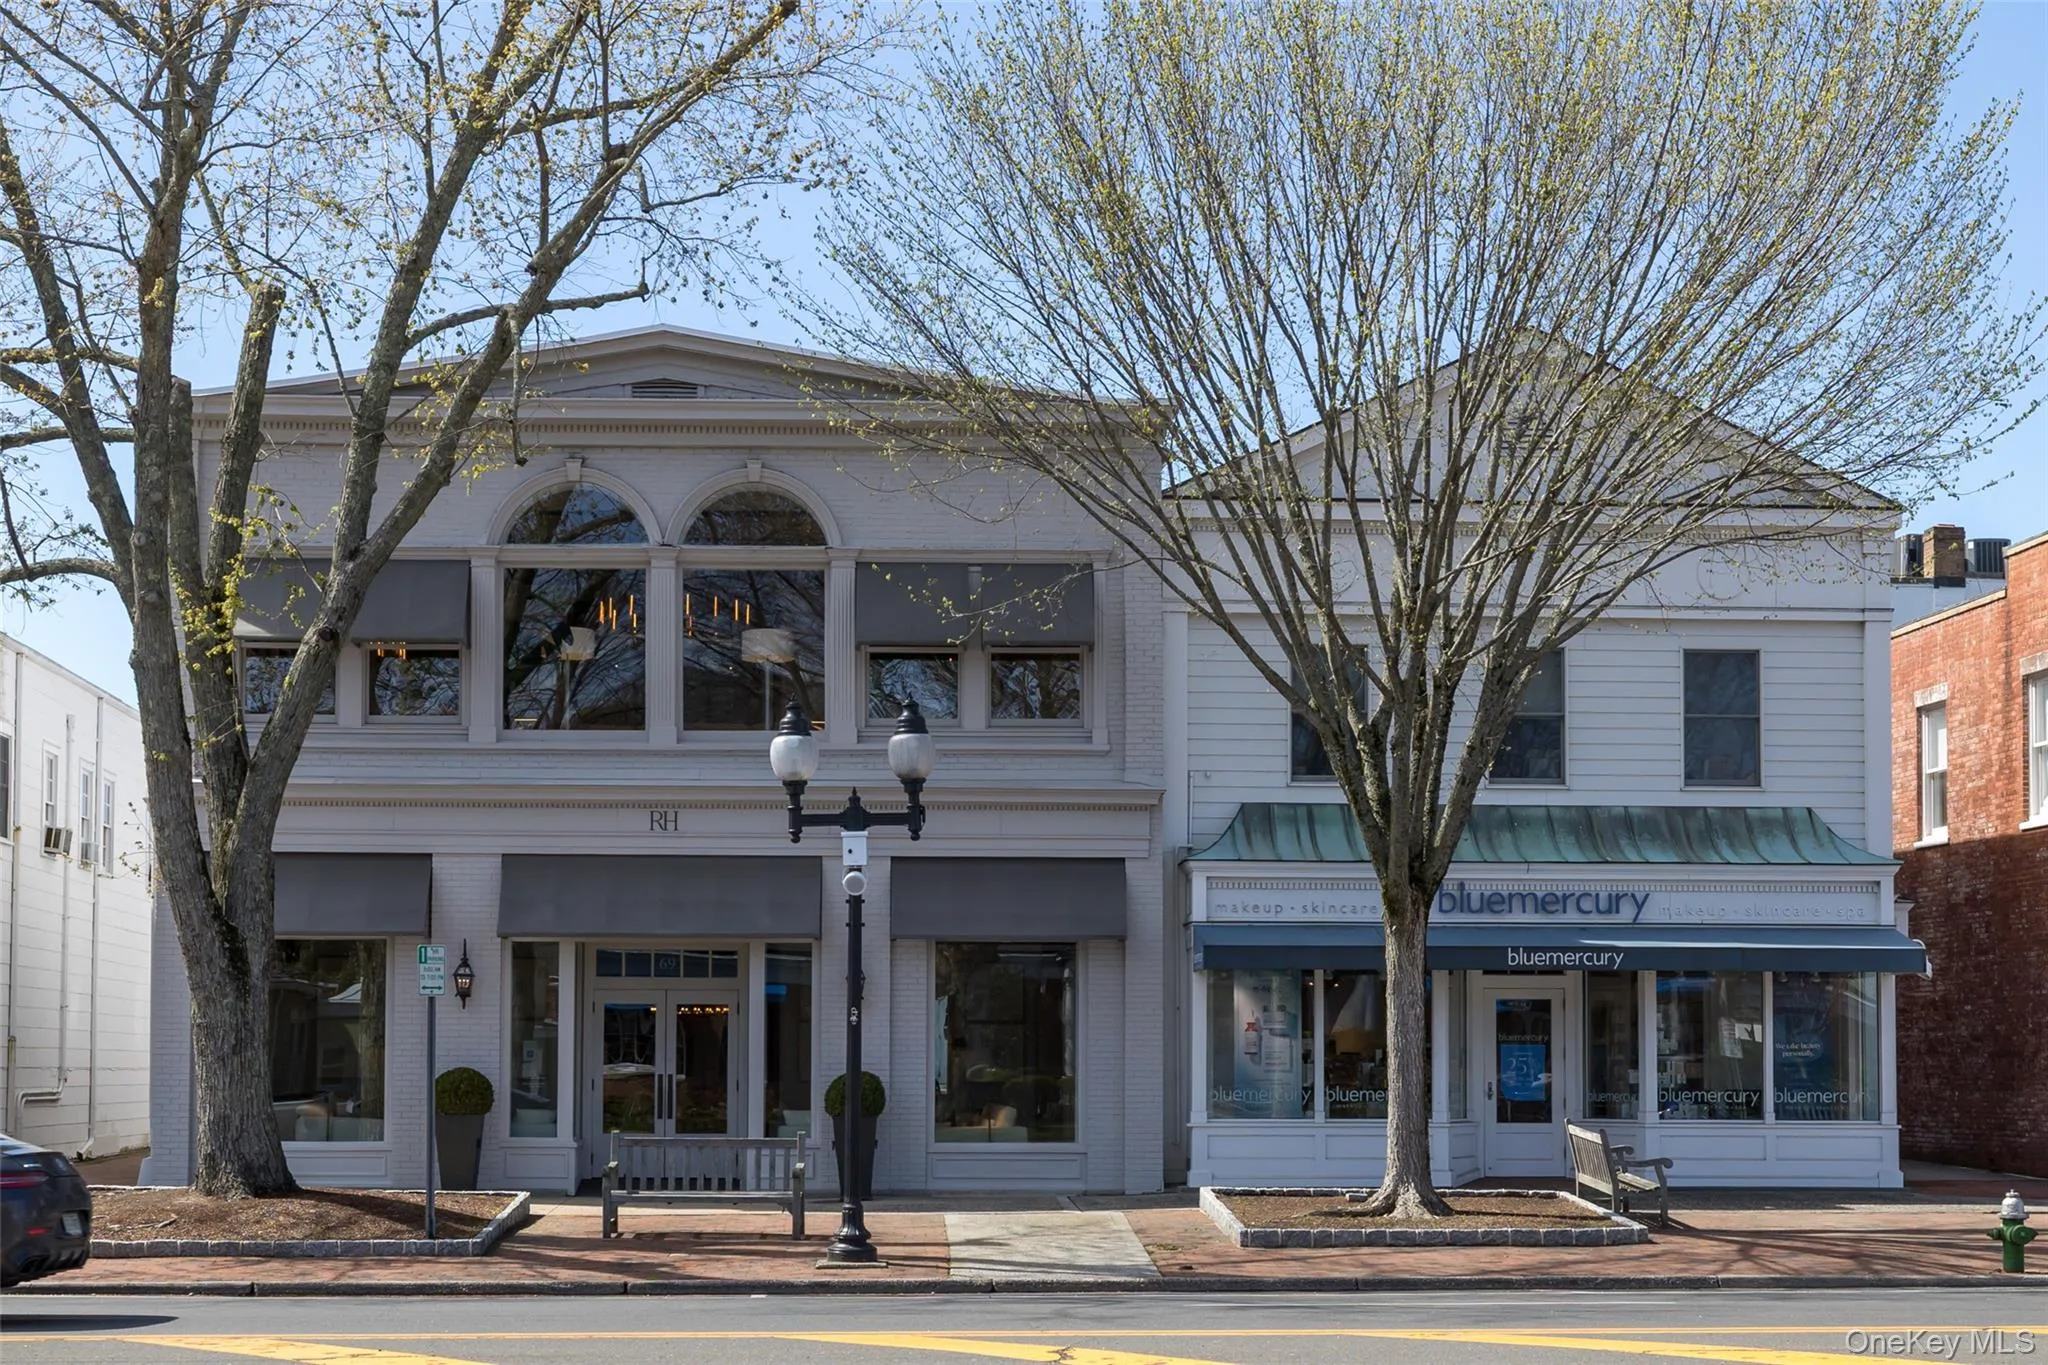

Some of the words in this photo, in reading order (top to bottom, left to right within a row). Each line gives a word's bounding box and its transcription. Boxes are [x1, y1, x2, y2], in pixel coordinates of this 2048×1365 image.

[649, 810, 680, 831] RH
[1214, 901, 1284, 917] makeup
[1302, 901, 1379, 915] skincare
[1438, 881, 1650, 923] bluemercury
[1744, 903, 1822, 917] skincare
[1835, 907, 1866, 920] spa
[1508, 947, 1624, 969] bluemercury
[1659, 1087, 1761, 1107] bluemercury
